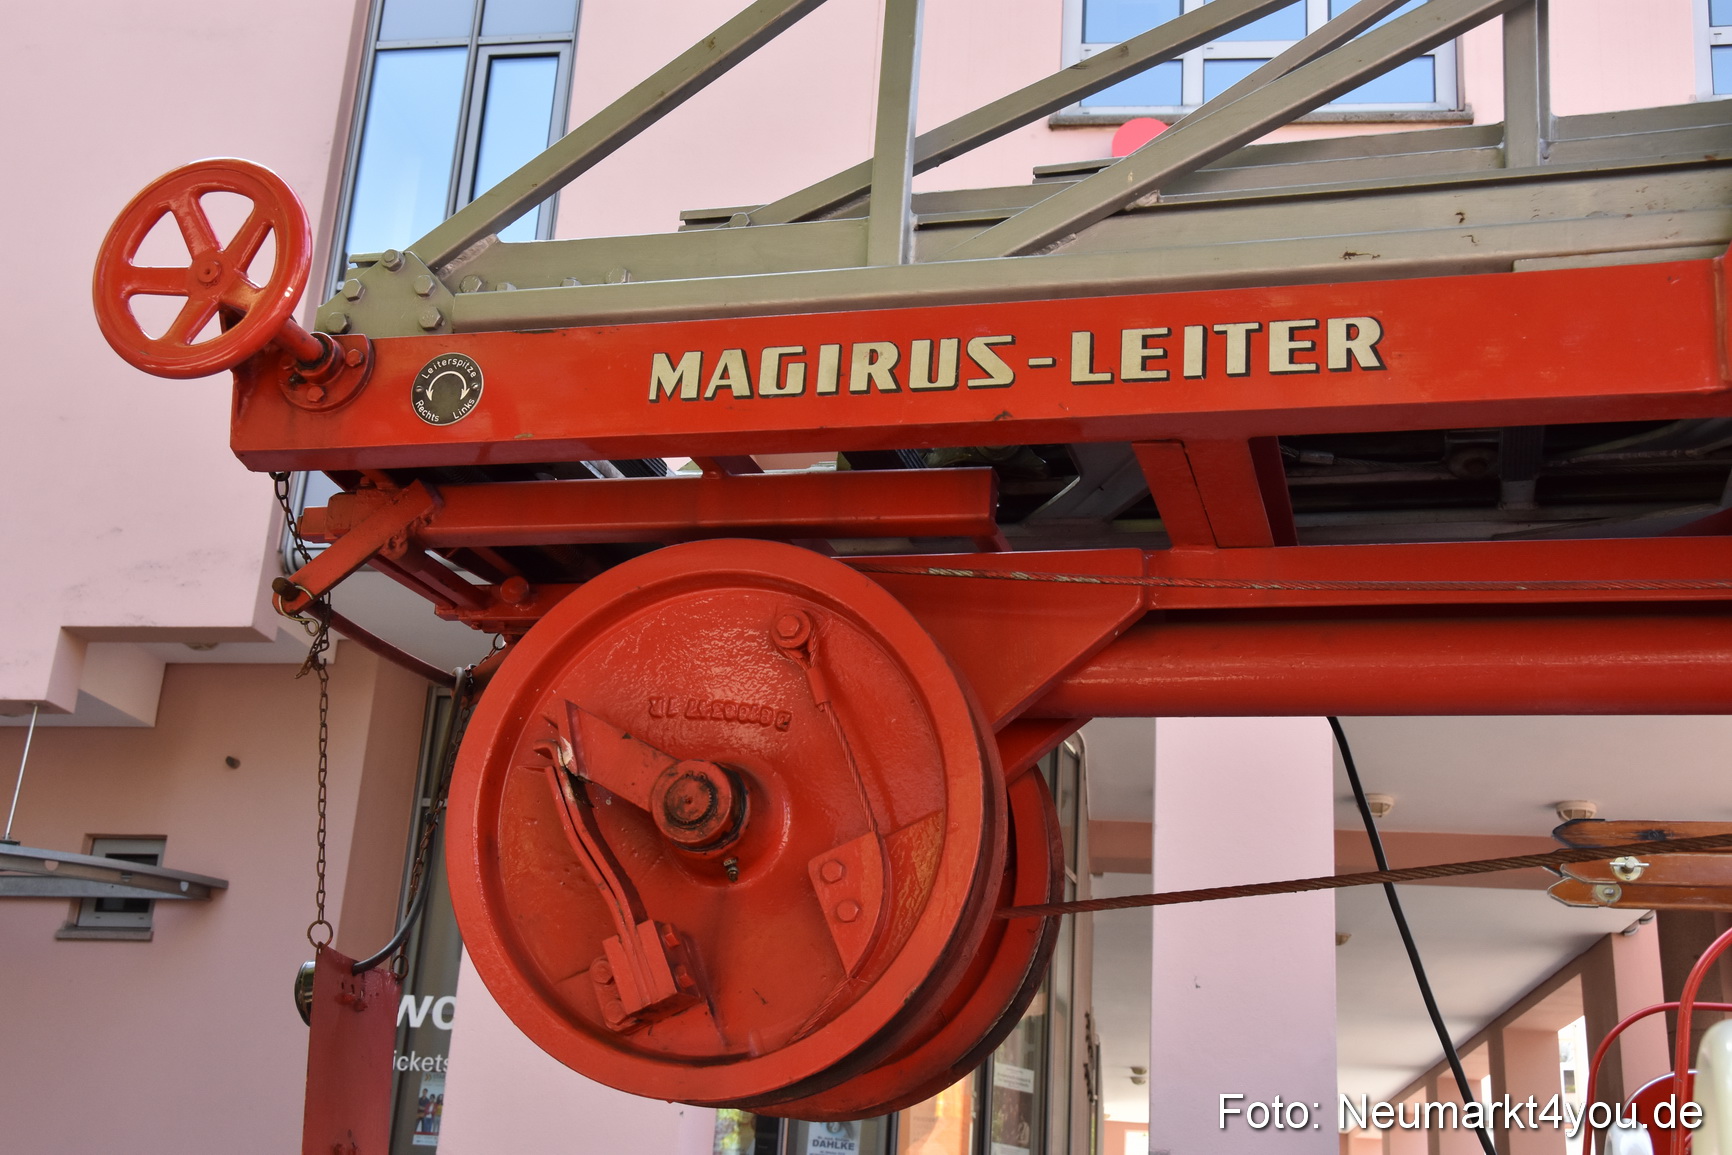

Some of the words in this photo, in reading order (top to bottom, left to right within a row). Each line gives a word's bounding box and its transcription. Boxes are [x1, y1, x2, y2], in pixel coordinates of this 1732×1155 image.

[421, 358, 477, 378] Leiterspitze
[649, 316, 1386, 402] MAGIRUS-LEITER
[415, 399, 440, 422] Rechts
[452, 398, 475, 420] Links
[812, 1139, 855, 1151] DAHLKE
